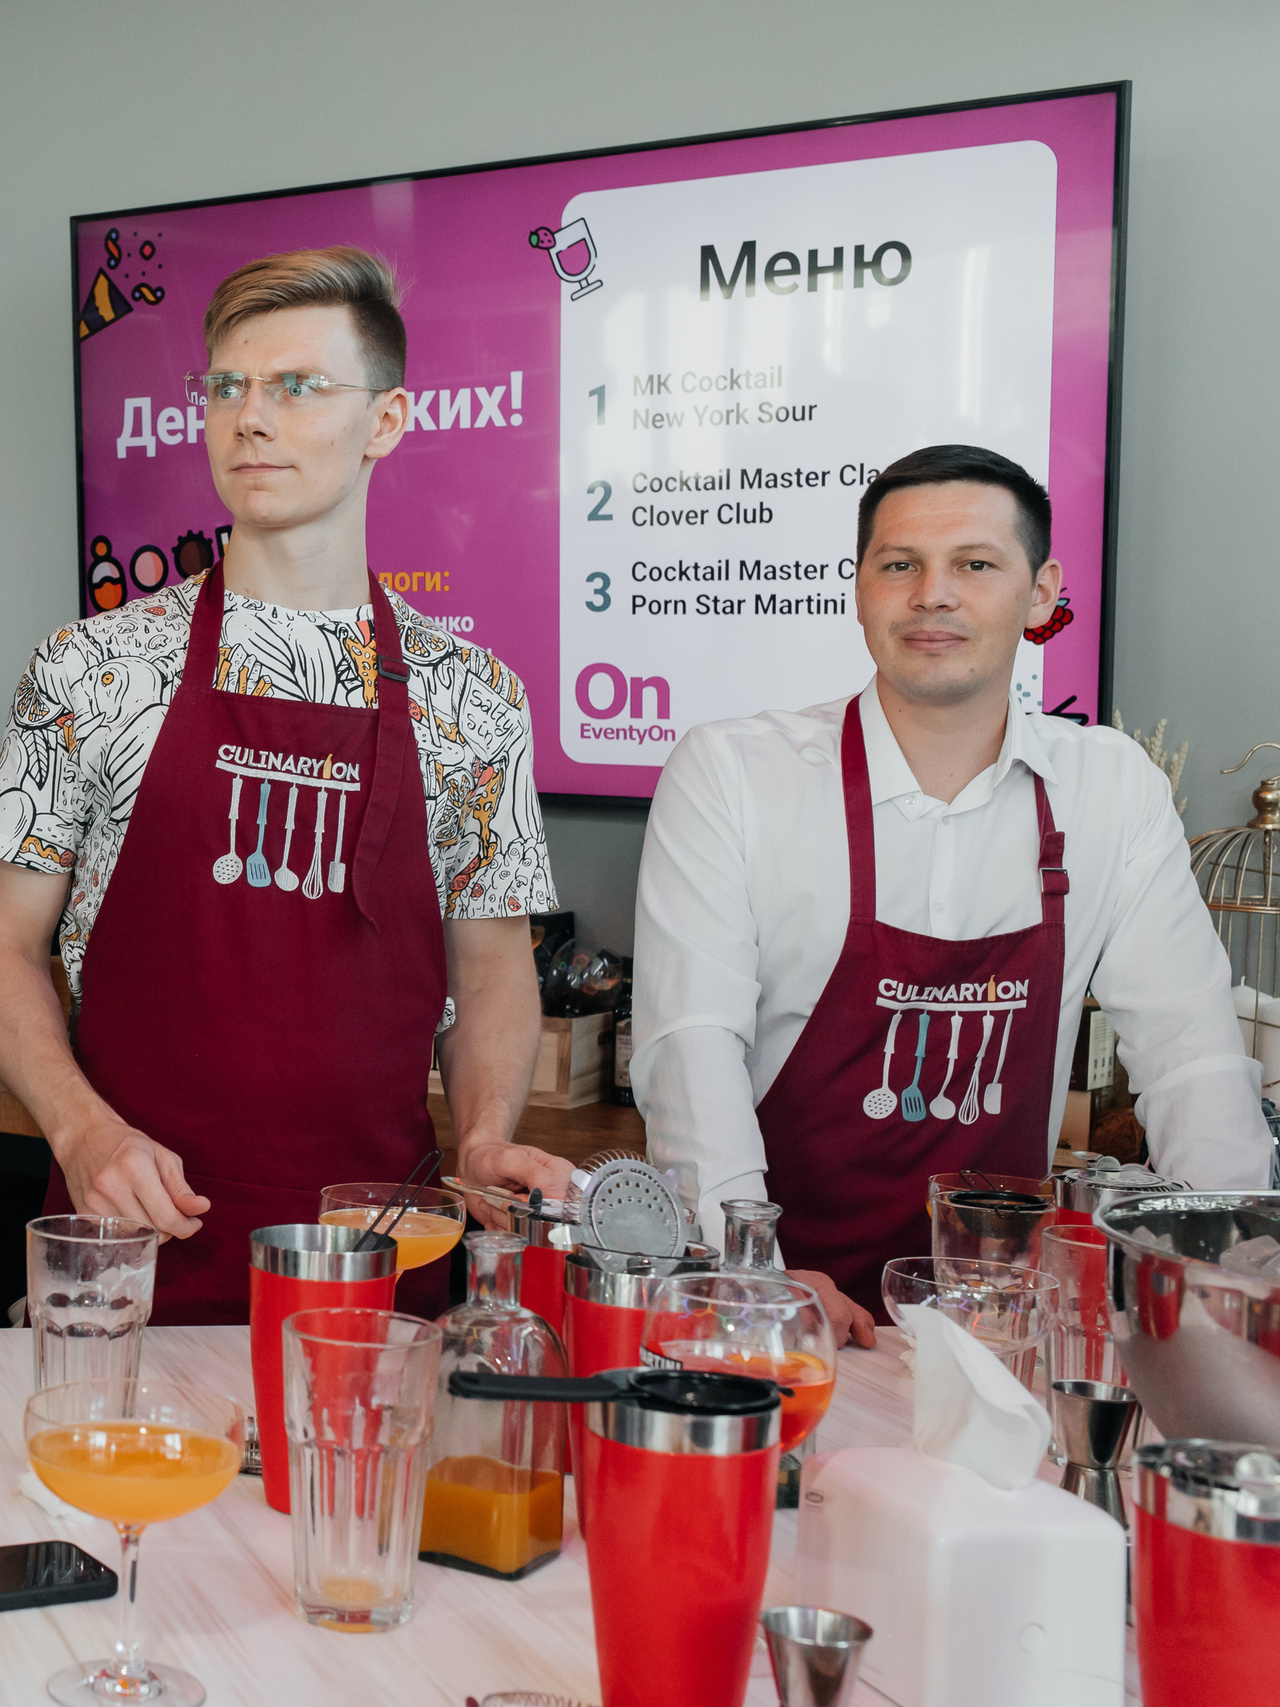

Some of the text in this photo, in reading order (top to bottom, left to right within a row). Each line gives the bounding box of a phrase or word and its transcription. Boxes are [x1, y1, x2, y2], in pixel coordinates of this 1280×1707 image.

[699, 239, 913, 302] Меню
[681, 364, 783, 394] Cocktail
[116, 370, 524, 459] Ден ких!
[588, 383, 607, 426] 1
[632, 401, 818, 430] New York Sour
[631, 463, 881, 494] Cocktail Master Cla
[586, 480, 614, 522] 2
[631, 501, 774, 527] Clover Club
[378, 571, 451, 592] логи:
[631, 558, 856, 582] Cocktail Master C
[585, 571, 612, 613] 3
[631, 592, 847, 615] Porn Star Martini
[424, 615, 475, 633] нко
[575, 662, 671, 720] On
[579, 723, 677, 745] EventyOn
